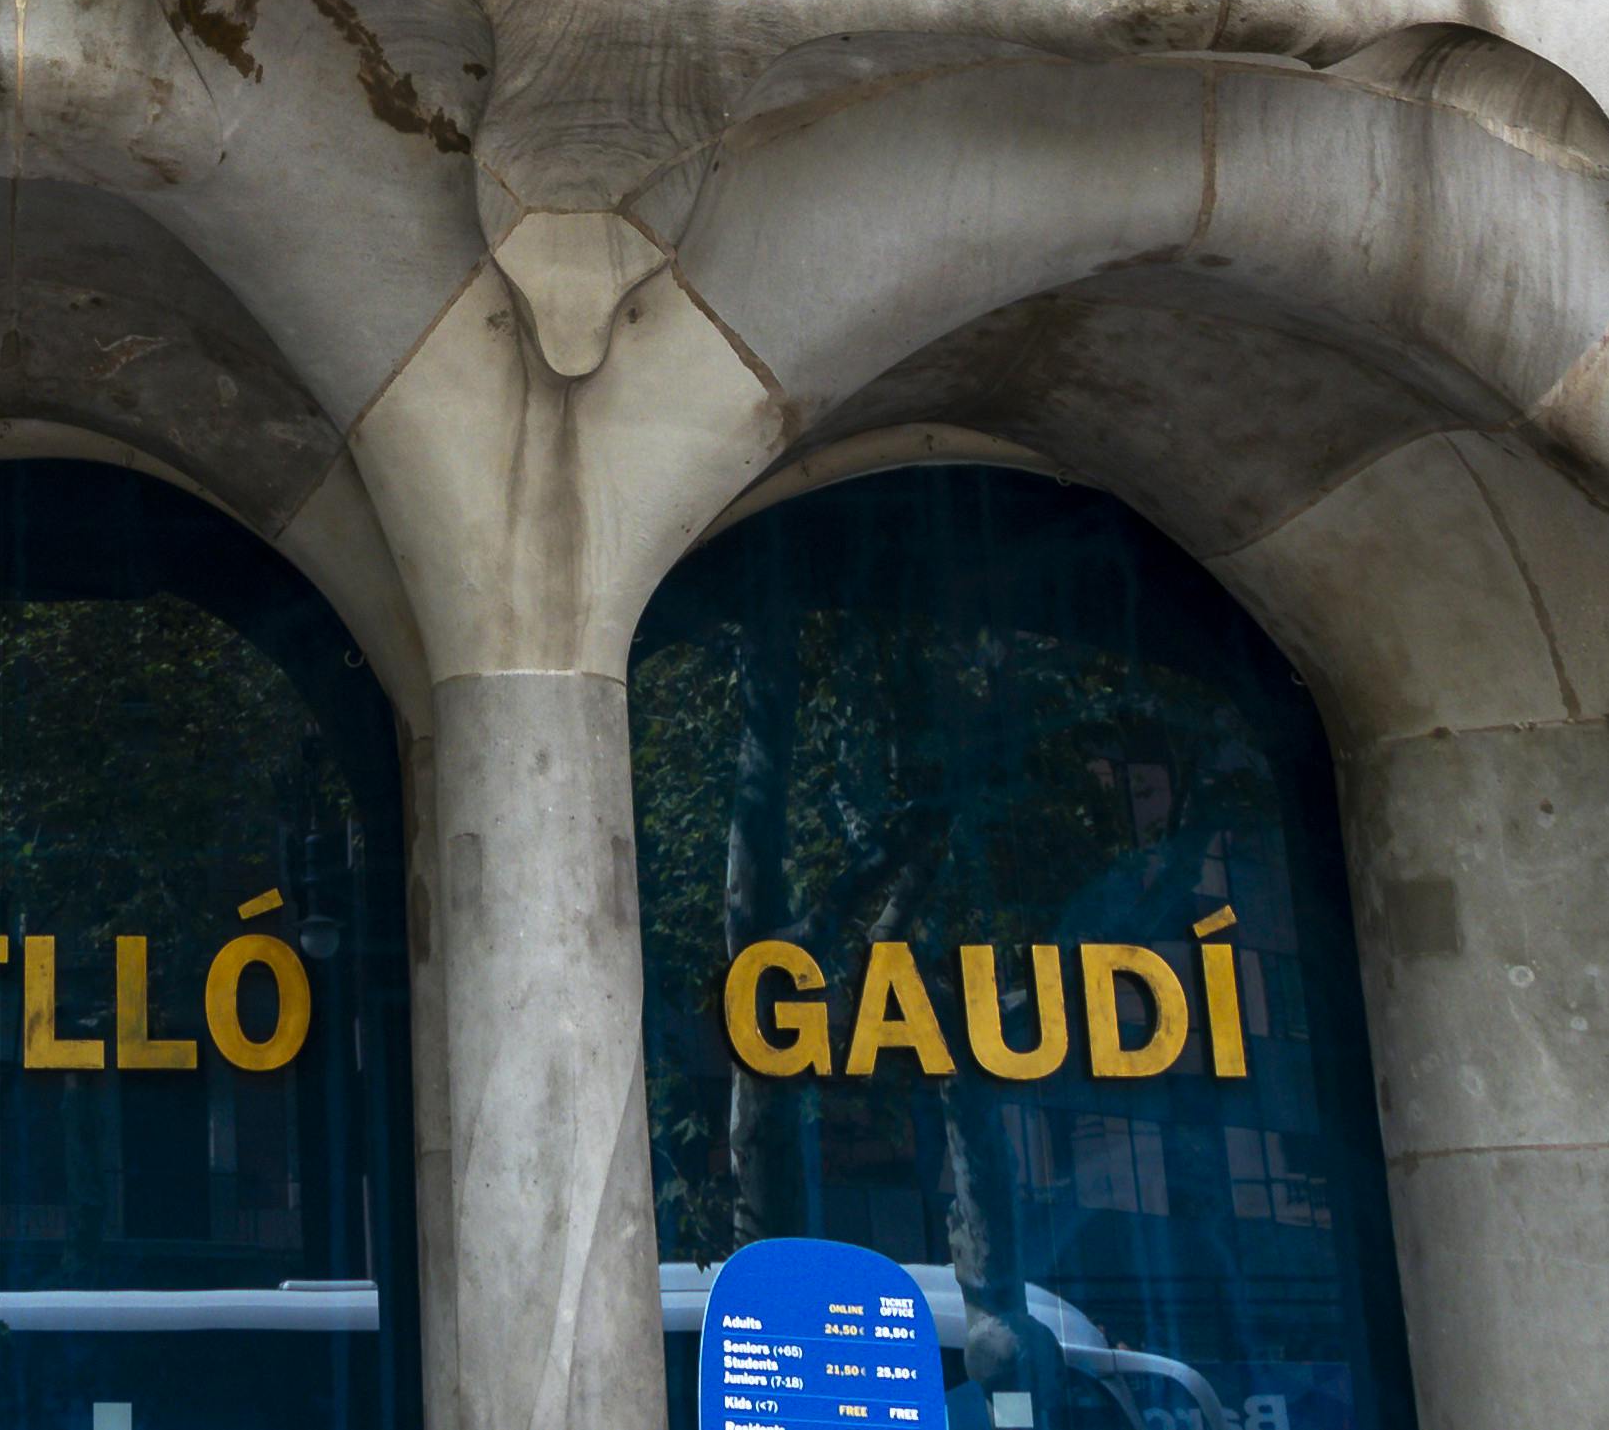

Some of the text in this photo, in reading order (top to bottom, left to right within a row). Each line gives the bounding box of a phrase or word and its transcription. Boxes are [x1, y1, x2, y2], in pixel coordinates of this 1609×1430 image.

[724, 905, 1247, 1081] GAUDÍ
[829, 1304, 864, 1316] ONLINE
[880, 1297, 914, 1308] TICKET
[880, 1307, 915, 1318] OFFICE
[723, 1315, 763, 1330] Adults
[724, 1340, 803, 1359] Seniors (+65)
[724, 1355, 779, 1371] Students
[724, 1371, 768, 1387] Juniors
[725, 1396, 753, 1411] Kids
[839, 1405, 868, 1418] FREE
[890, 1408, 920, 1421] FREE
